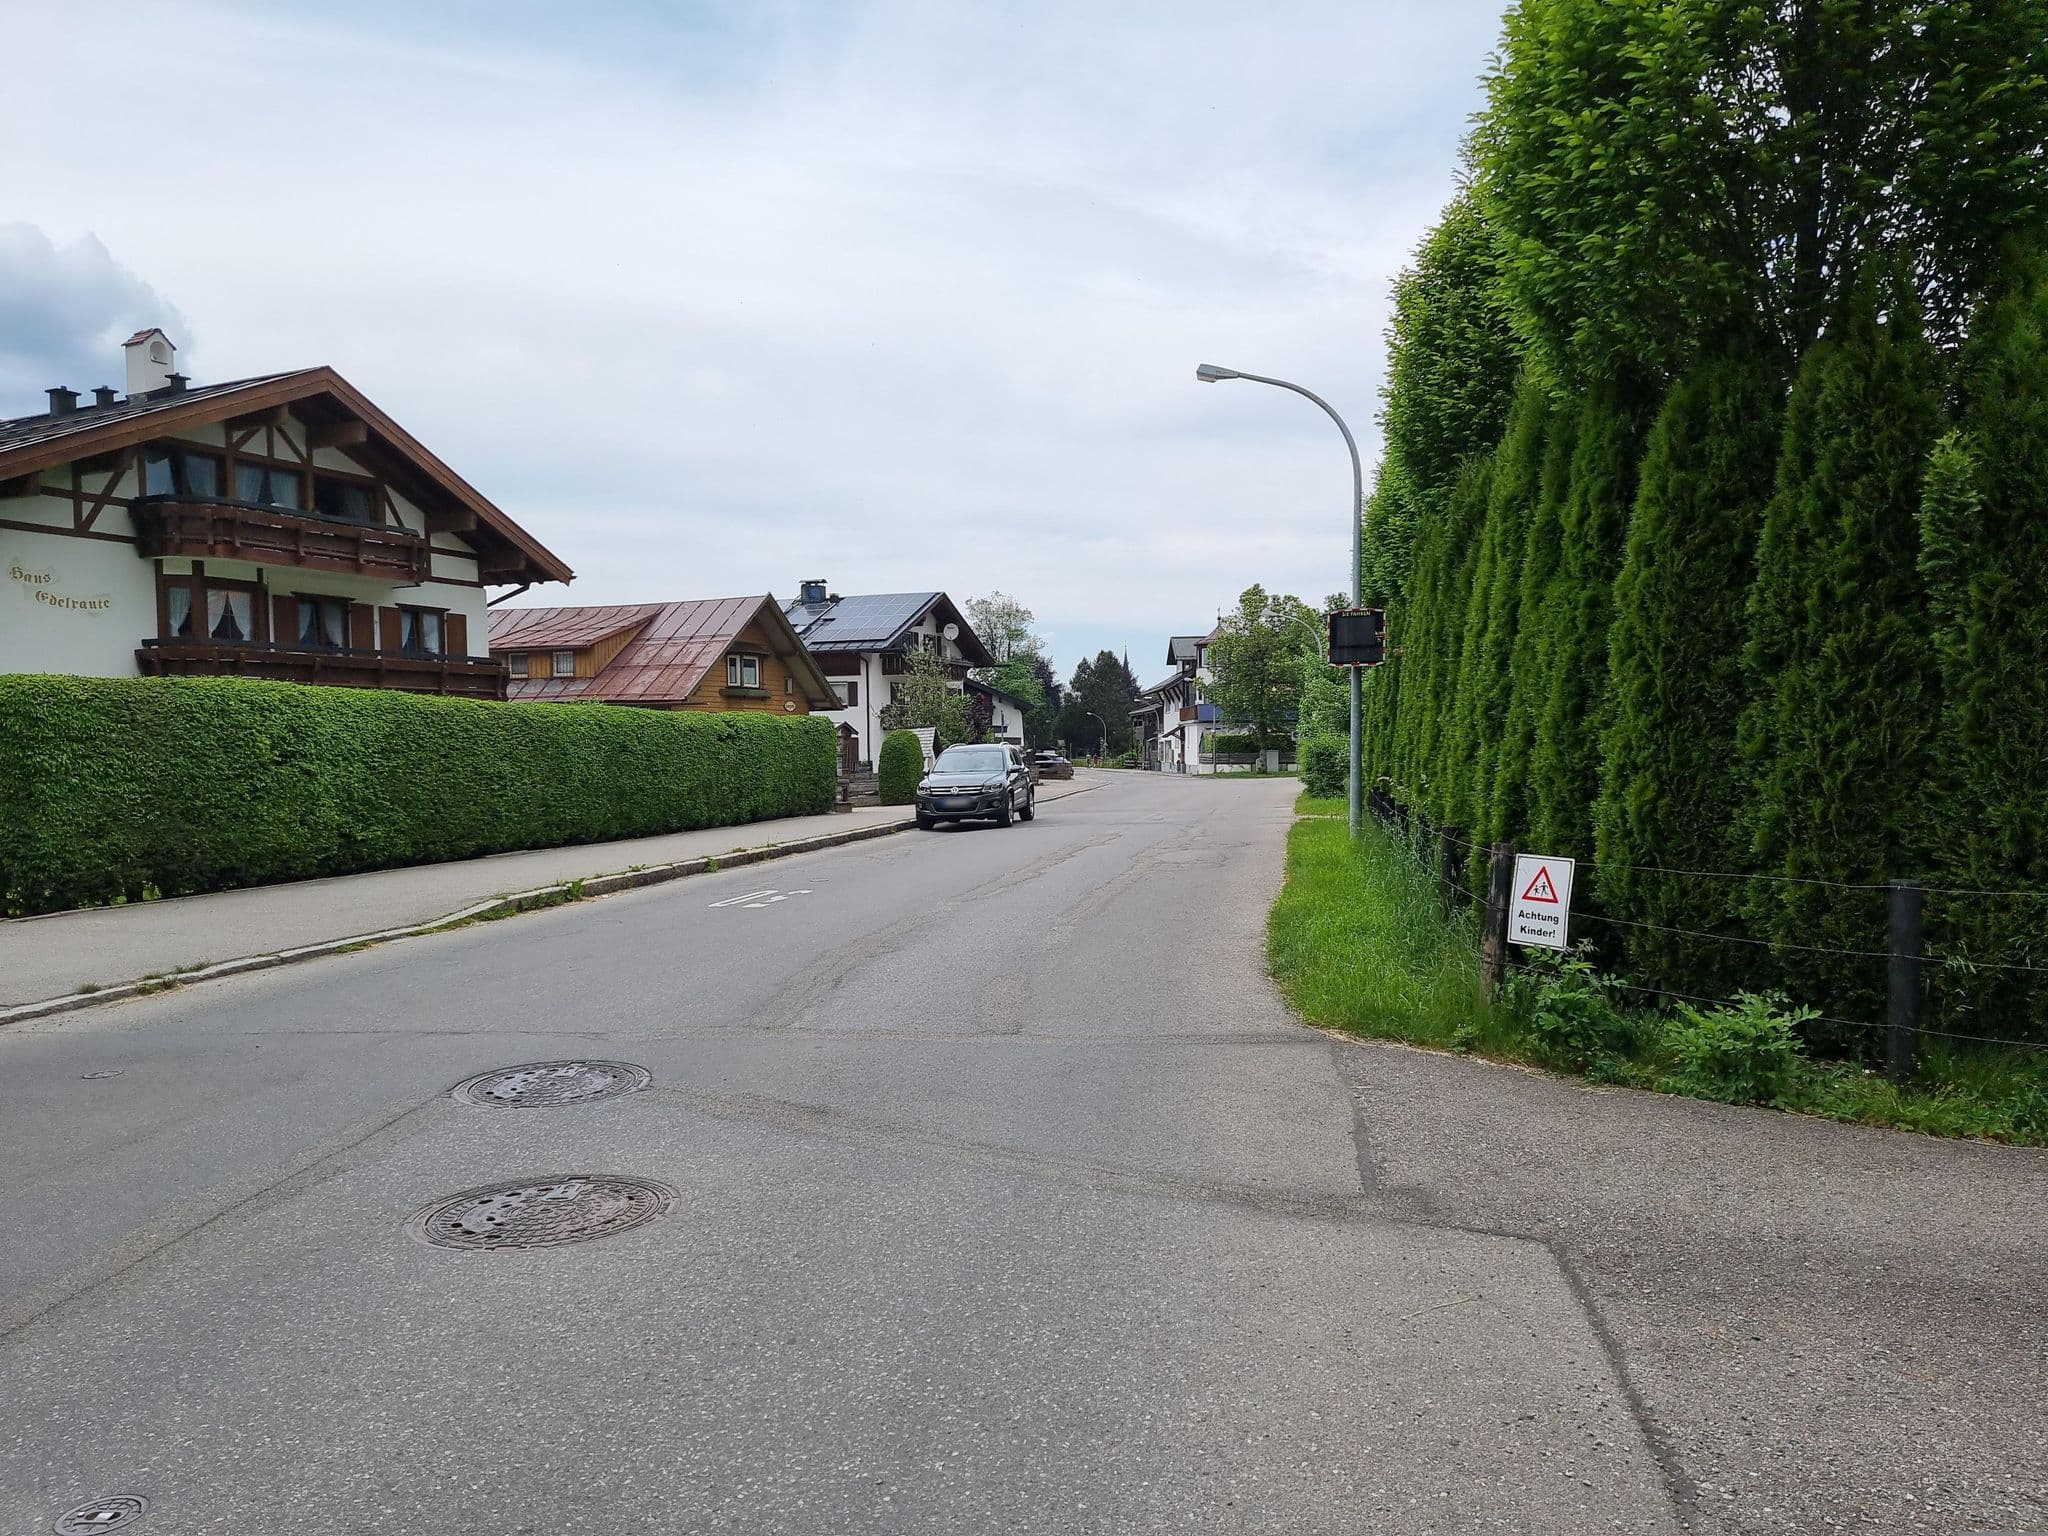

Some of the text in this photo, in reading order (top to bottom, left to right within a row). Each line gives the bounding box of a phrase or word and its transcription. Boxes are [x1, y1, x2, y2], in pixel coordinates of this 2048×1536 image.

[35, 590, 110, 609] Edelraute
[1518, 909, 1559, 925] Achtung
[1520, 924, 1556, 938] Kinder!
